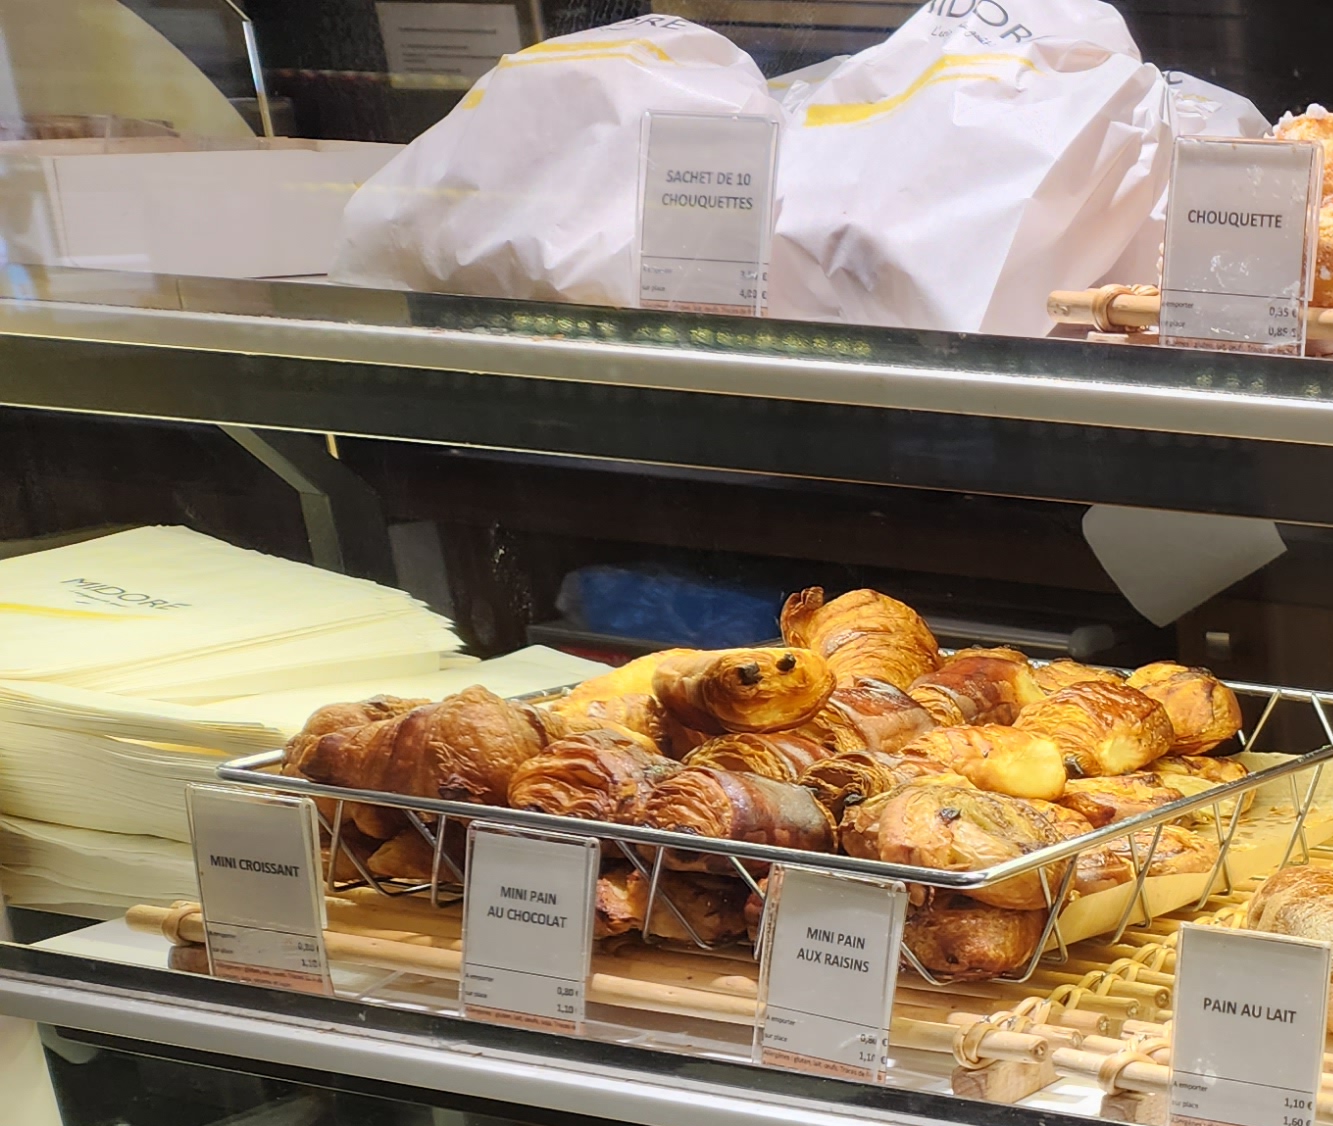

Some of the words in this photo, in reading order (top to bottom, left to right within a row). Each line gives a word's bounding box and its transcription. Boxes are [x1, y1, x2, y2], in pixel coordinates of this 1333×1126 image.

[929, 0, 1042, 43] IDOR
[666, 169, 713, 185] SACHET
[716, 172, 733, 186] DE
[737, 173, 751, 186] 10
[662, 193, 753, 210] CHOUQUETTES
[1187, 209, 1283, 228] CHOUQUETTE
[209, 854, 237, 870] MINI
[238, 858, 300, 878] CROISSANT
[500, 885, 527, 902] MINI
[530, 890, 557, 906] PAIN
[487, 905, 504, 919] AU
[507, 908, 568, 929] CHOCOLAT
[806, 926, 834, 944] MINI
[837, 933, 865, 950] PAIN
[797, 947, 822, 964] AUX
[824, 952, 870, 974] RAISINS
[1203, 996, 1237, 1015] PAIN
[1240, 1003, 1262, 1019] AU
[1266, 1007, 1297, 1024] LAIT
[1284, 1098, 1304, 1110] 1,10
